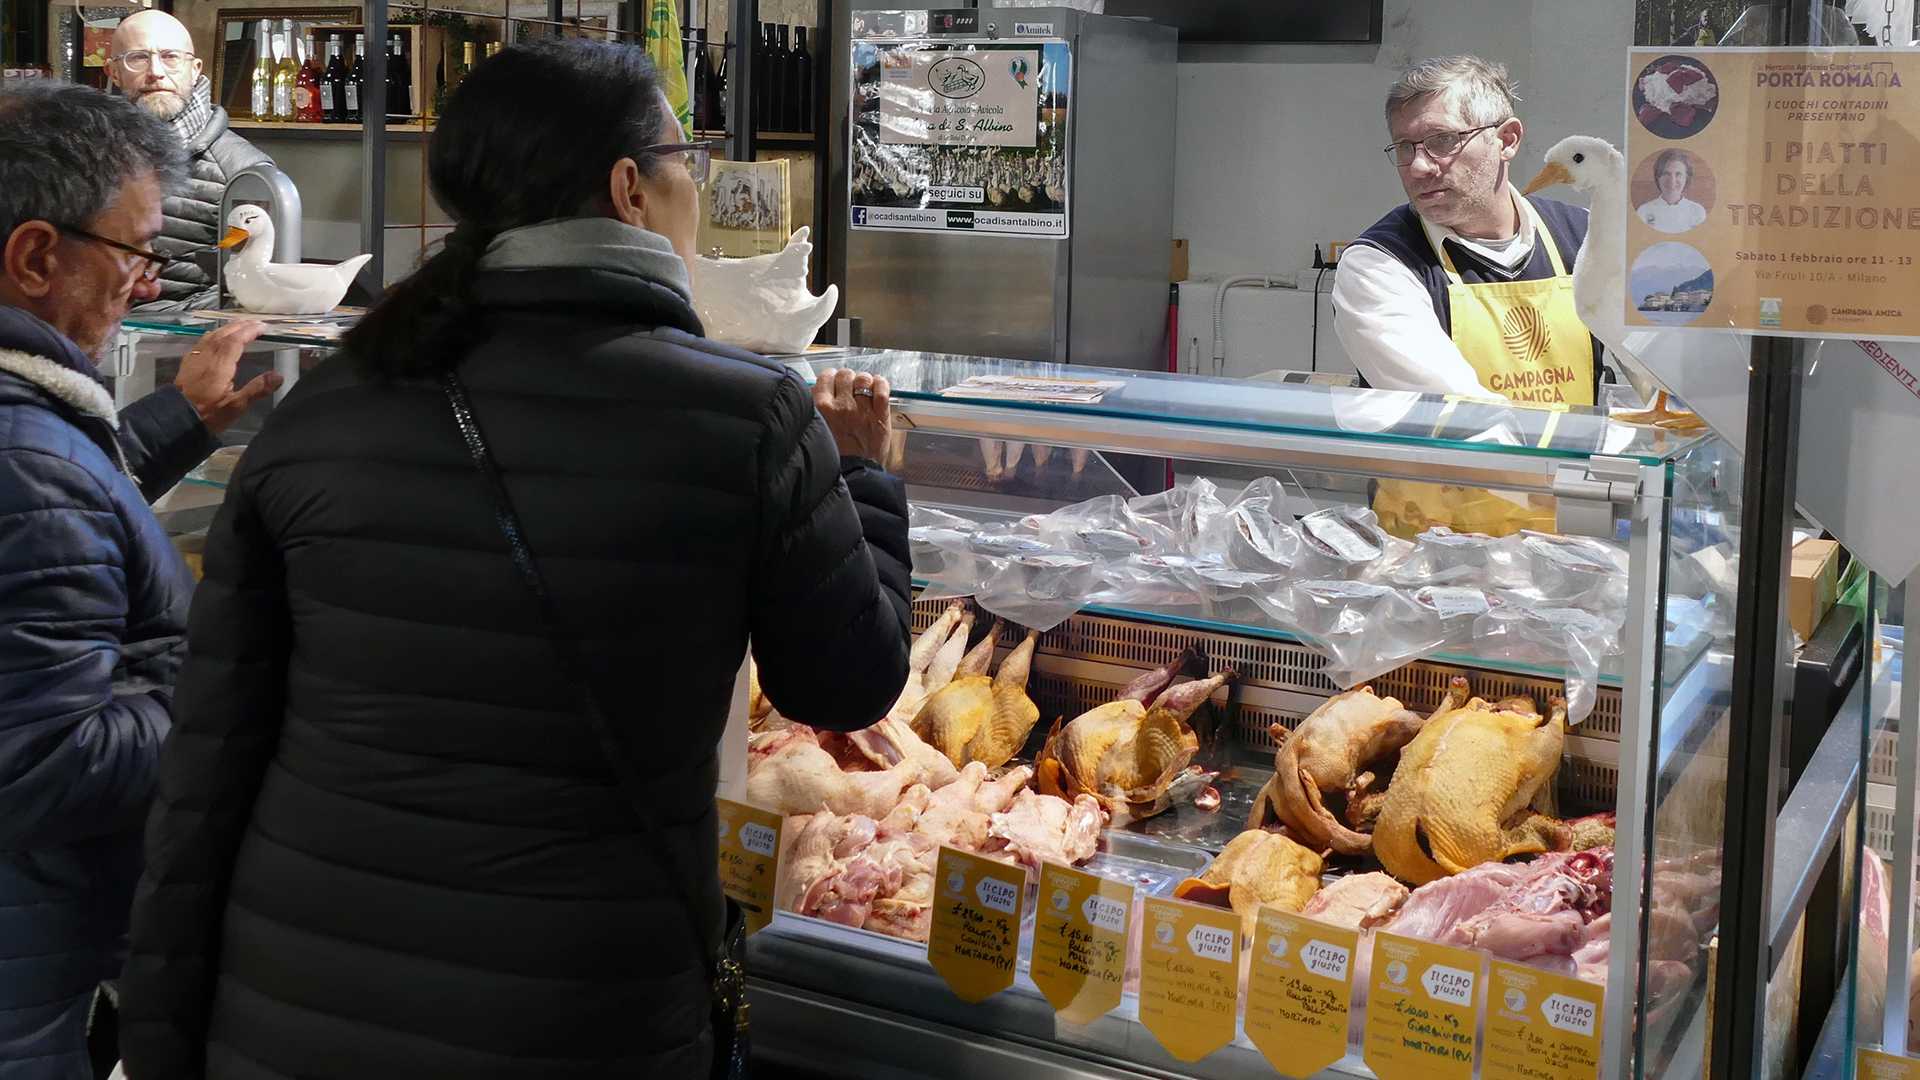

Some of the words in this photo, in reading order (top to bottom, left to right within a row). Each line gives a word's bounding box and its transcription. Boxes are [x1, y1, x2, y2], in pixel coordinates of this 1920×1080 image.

[1757, 72, 1815, 87] PORTA
[1774, 101, 1818, 110] CUOCHI
[1823, 101, 1888, 110] CONTADINI
[1787, 112, 1866, 121] PRESENTANO
[955, 119, 969, 130] S.
[974, 119, 1014, 132] Albino
[1765, 142, 1772, 163] I
[1786, 142, 1887, 165] PIATTI
[1777, 173, 1874, 196] DELLA
[928, 188, 966, 201] seguici
[968, 190, 982, 200] su
[947, 214, 1062, 228] www.ocadisantalbino.it
[1728, 204, 1920, 230] TRADIZIONE
[1736, 252, 1776, 262] Sabato
[1780, 253, 1786, 262] 1
[1790, 252, 1842, 264] febbraio
[1848, 256, 1867, 264] ore
[1871, 256, 1884, 265] 11
[1898, 256, 1912, 265] 13
[1755, 270, 1772, 280] Via
[1848, 272, 1887, 284] Milano
[1876, 309, 1902, 318] AMICA
[1489, 366, 1576, 392] CAMPAGNA
[1512, 386, 1565, 403] AMICA
[1099, 903, 1124, 917] CIBO
[1204, 933, 1231, 946] CIBO
[1318, 948, 1346, 964] CIBO
[1311, 960, 1341, 973] giusto
[1441, 974, 1471, 989] CIBO
[1433, 985, 1465, 998] giusto
[1562, 1003, 1592, 1018] CIBO
[1554, 1014, 1588, 1026] giusto
